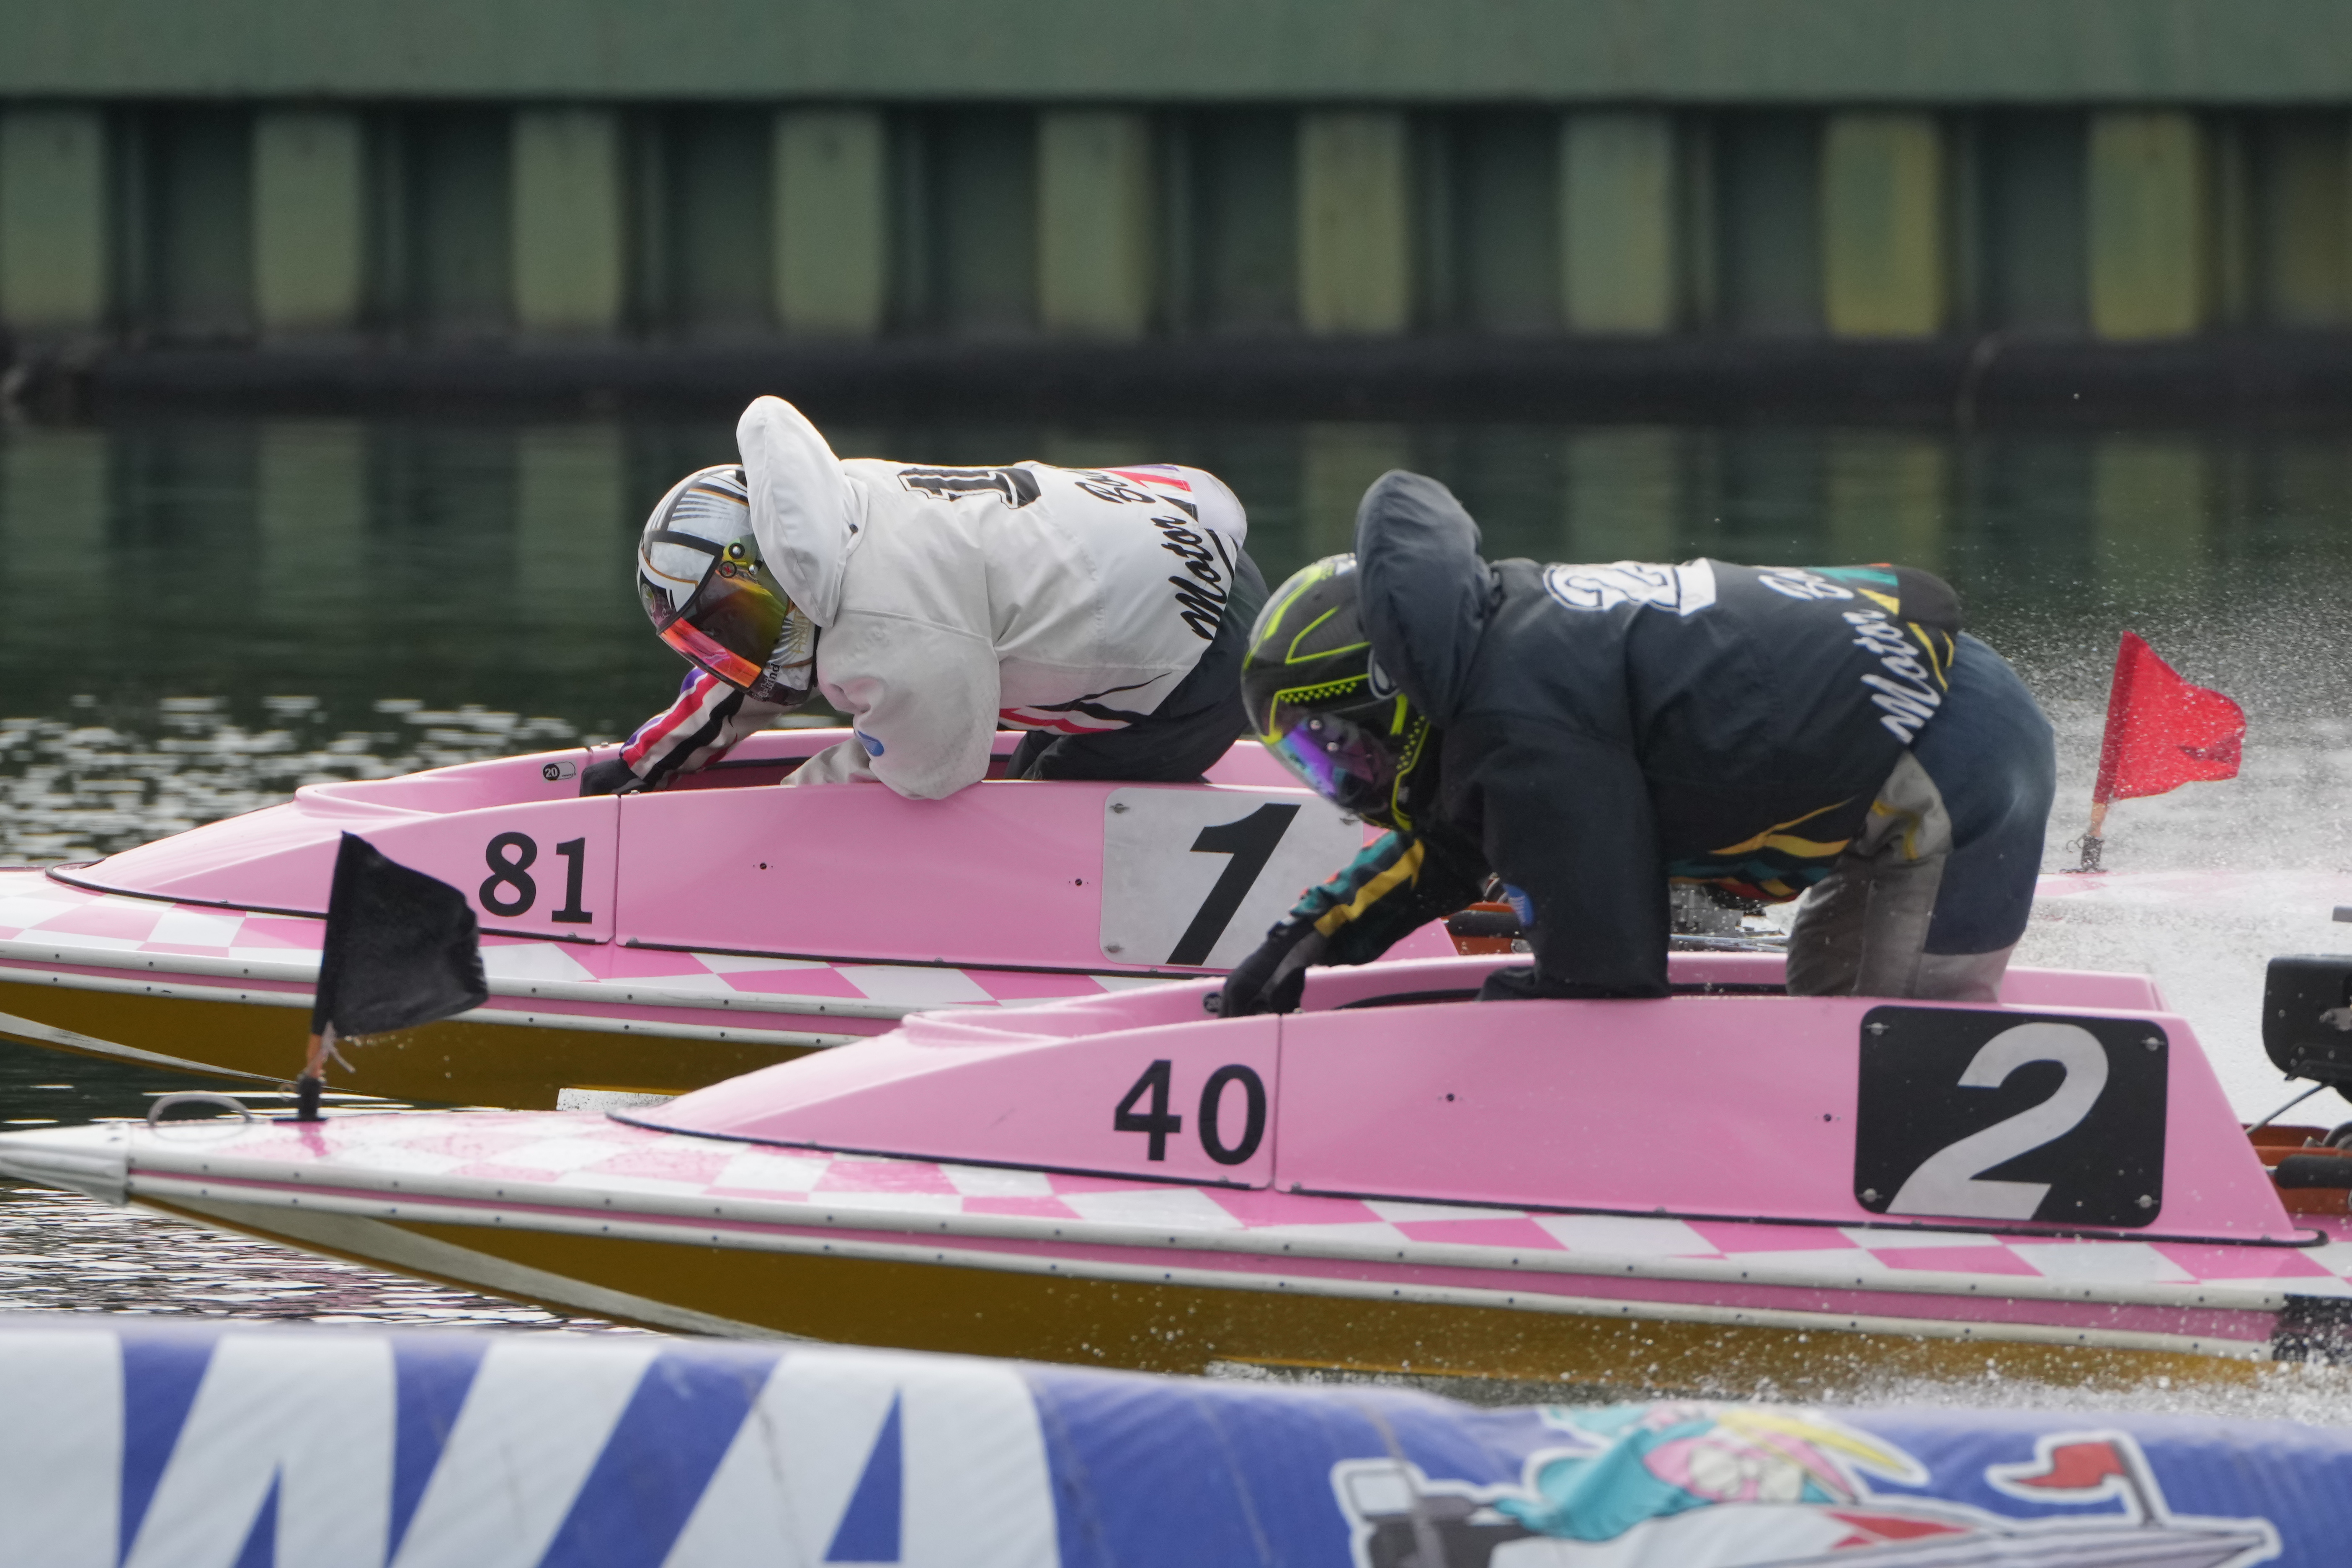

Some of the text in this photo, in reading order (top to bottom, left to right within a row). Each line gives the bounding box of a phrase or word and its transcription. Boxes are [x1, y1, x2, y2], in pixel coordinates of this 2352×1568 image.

[1150, 516, 1228, 640] Motor
[1842, 609, 1942, 744] Motor
[544, 767, 558, 778] 20
[479, 831, 593, 924] 81
[1166, 802, 1301, 966] 1
[1113, 1059, 1266, 1166] 40
[1885, 1021, 2110, 1221] 2
